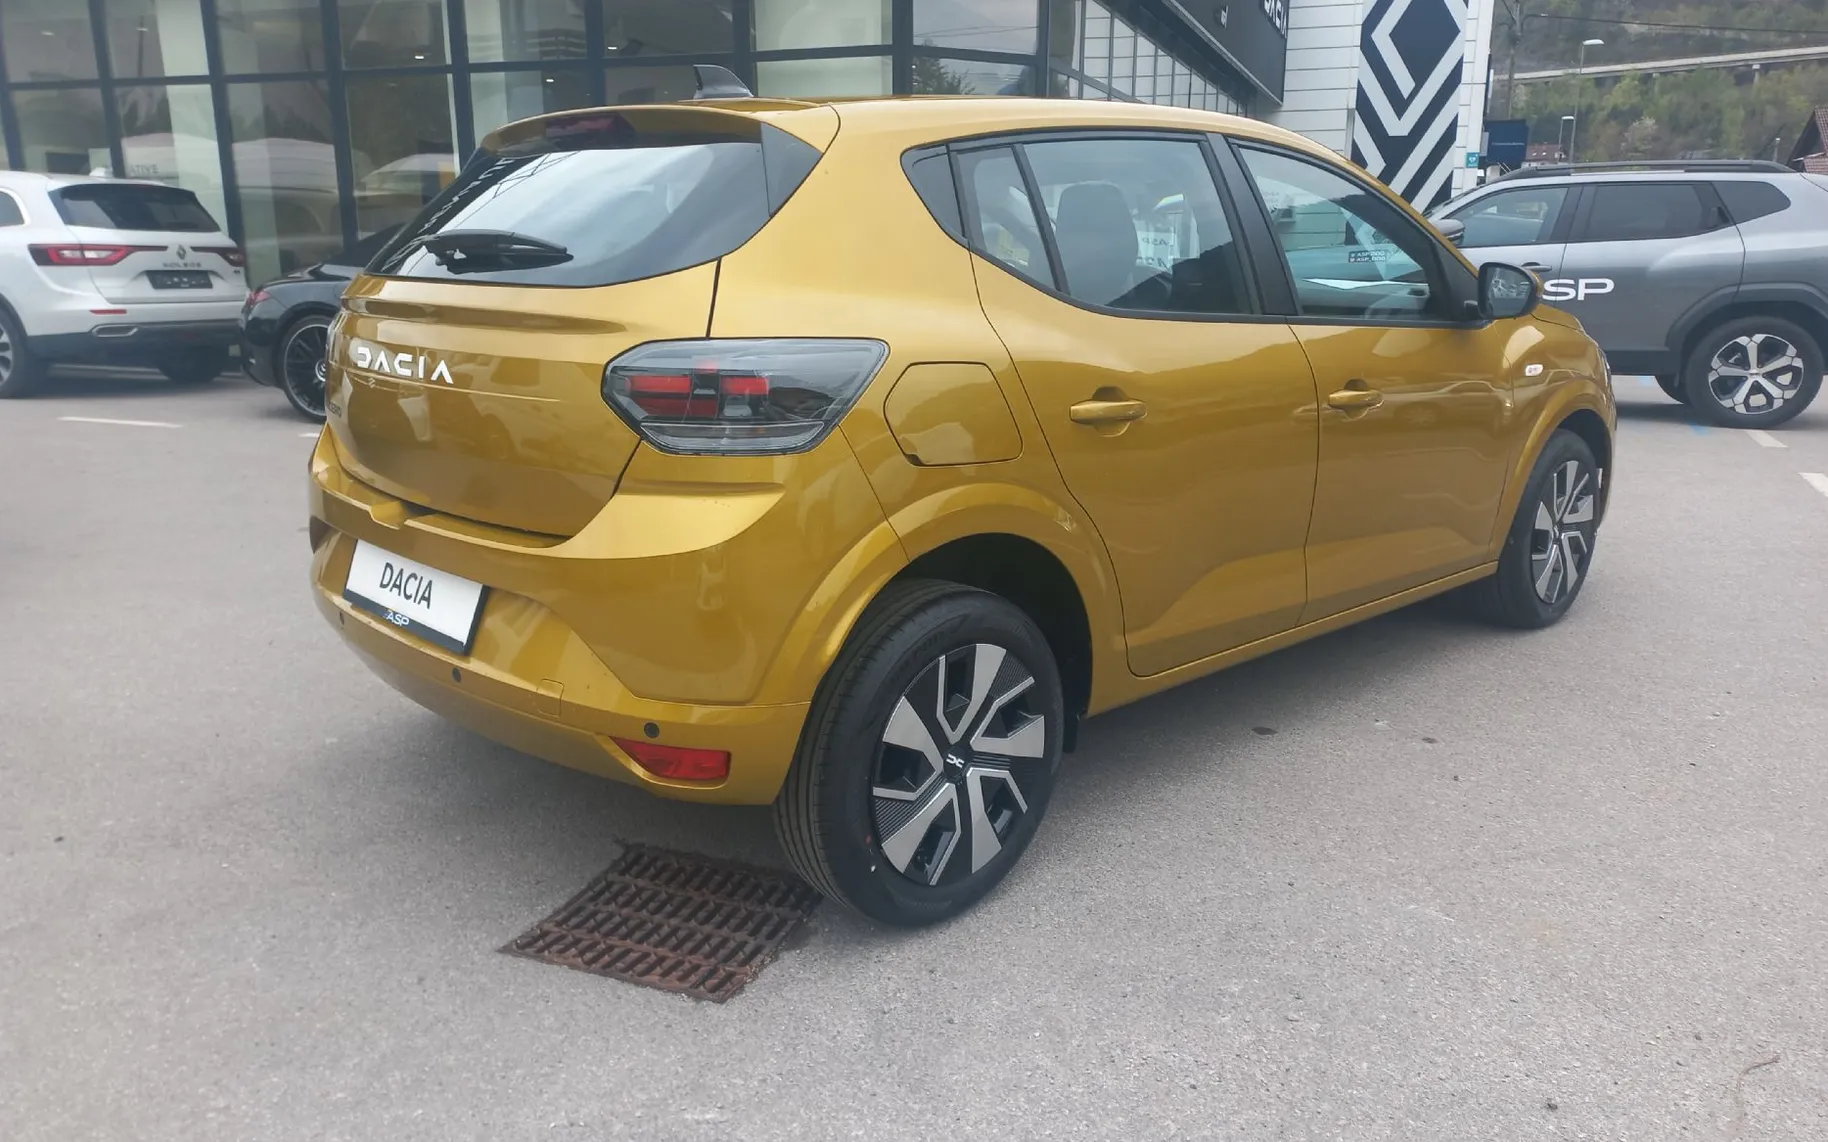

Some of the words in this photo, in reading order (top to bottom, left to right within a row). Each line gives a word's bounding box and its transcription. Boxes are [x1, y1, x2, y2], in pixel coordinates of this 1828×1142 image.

[1541, 278, 1615, 301] SP
[357, 346, 454, 385] DACIA
[379, 562, 433, 610] DACIA
[386, 611, 410, 627] ASP
